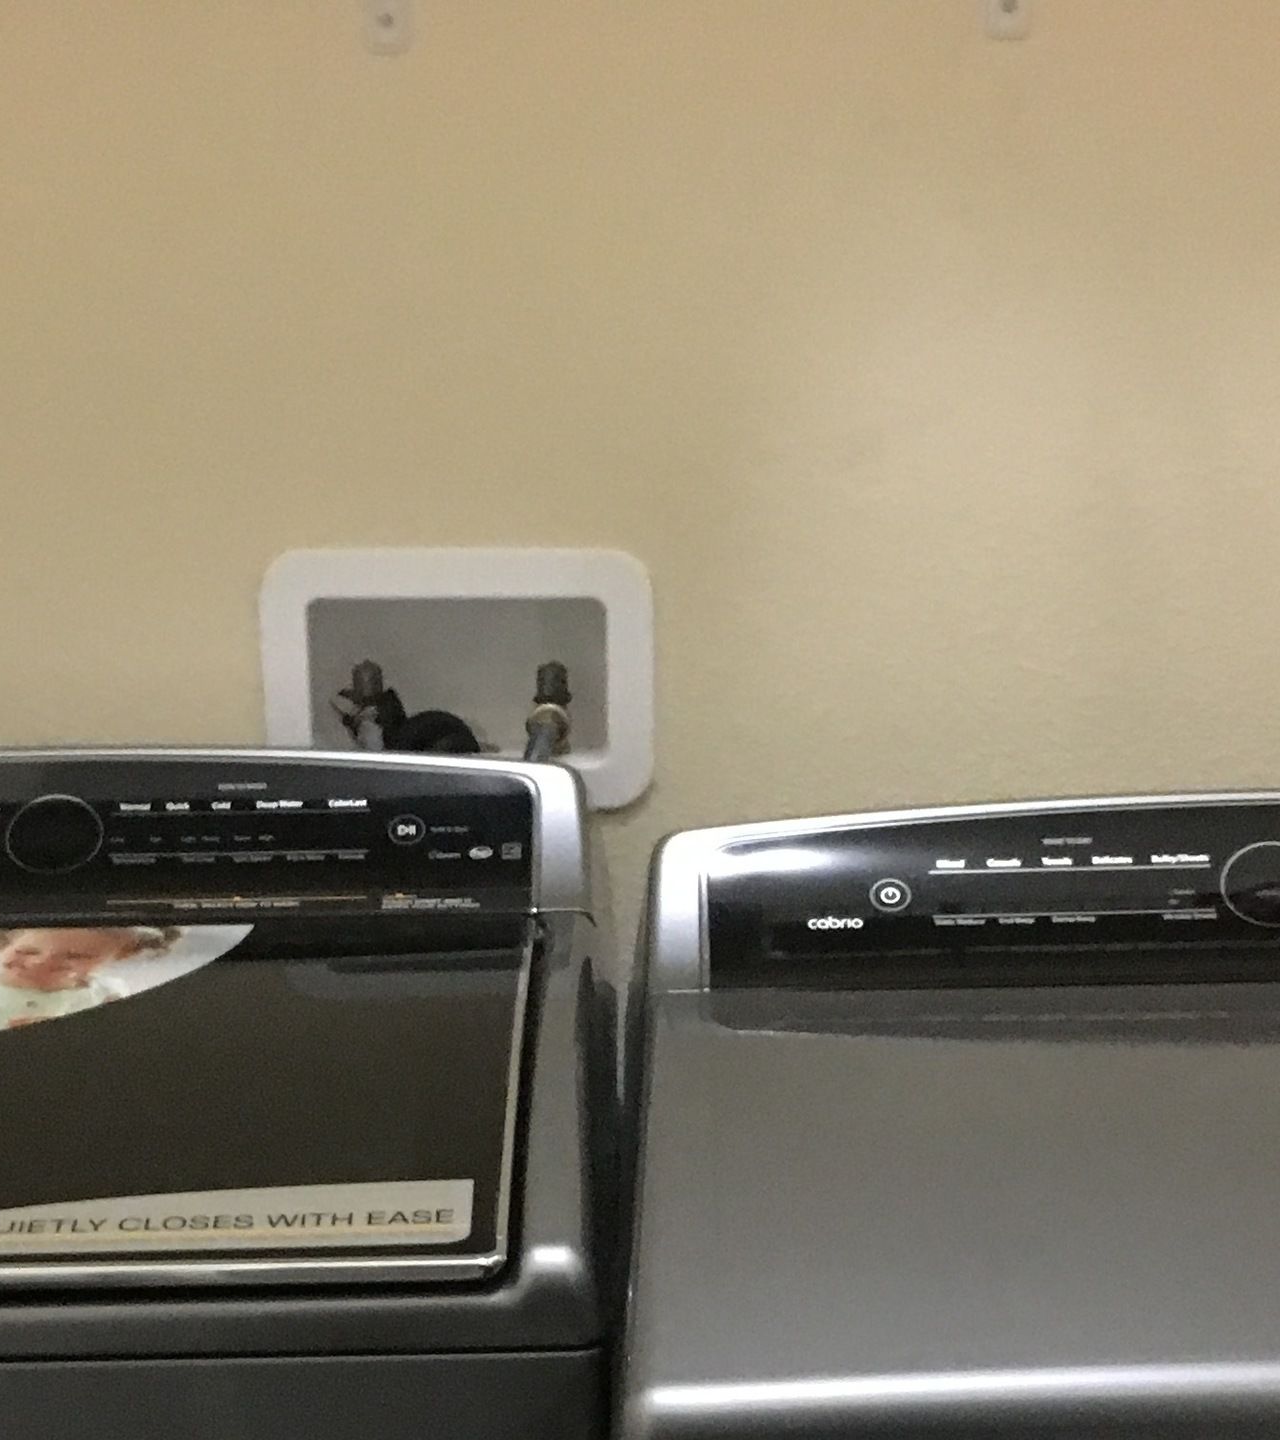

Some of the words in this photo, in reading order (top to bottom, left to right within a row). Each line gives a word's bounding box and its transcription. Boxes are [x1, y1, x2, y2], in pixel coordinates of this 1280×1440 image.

[807, 916, 864, 930] cabrio
[117, 1214, 254, 1232] CLOSES
[267, 1211, 355, 1229] WITH
[366, 1208, 455, 1226] EASE
